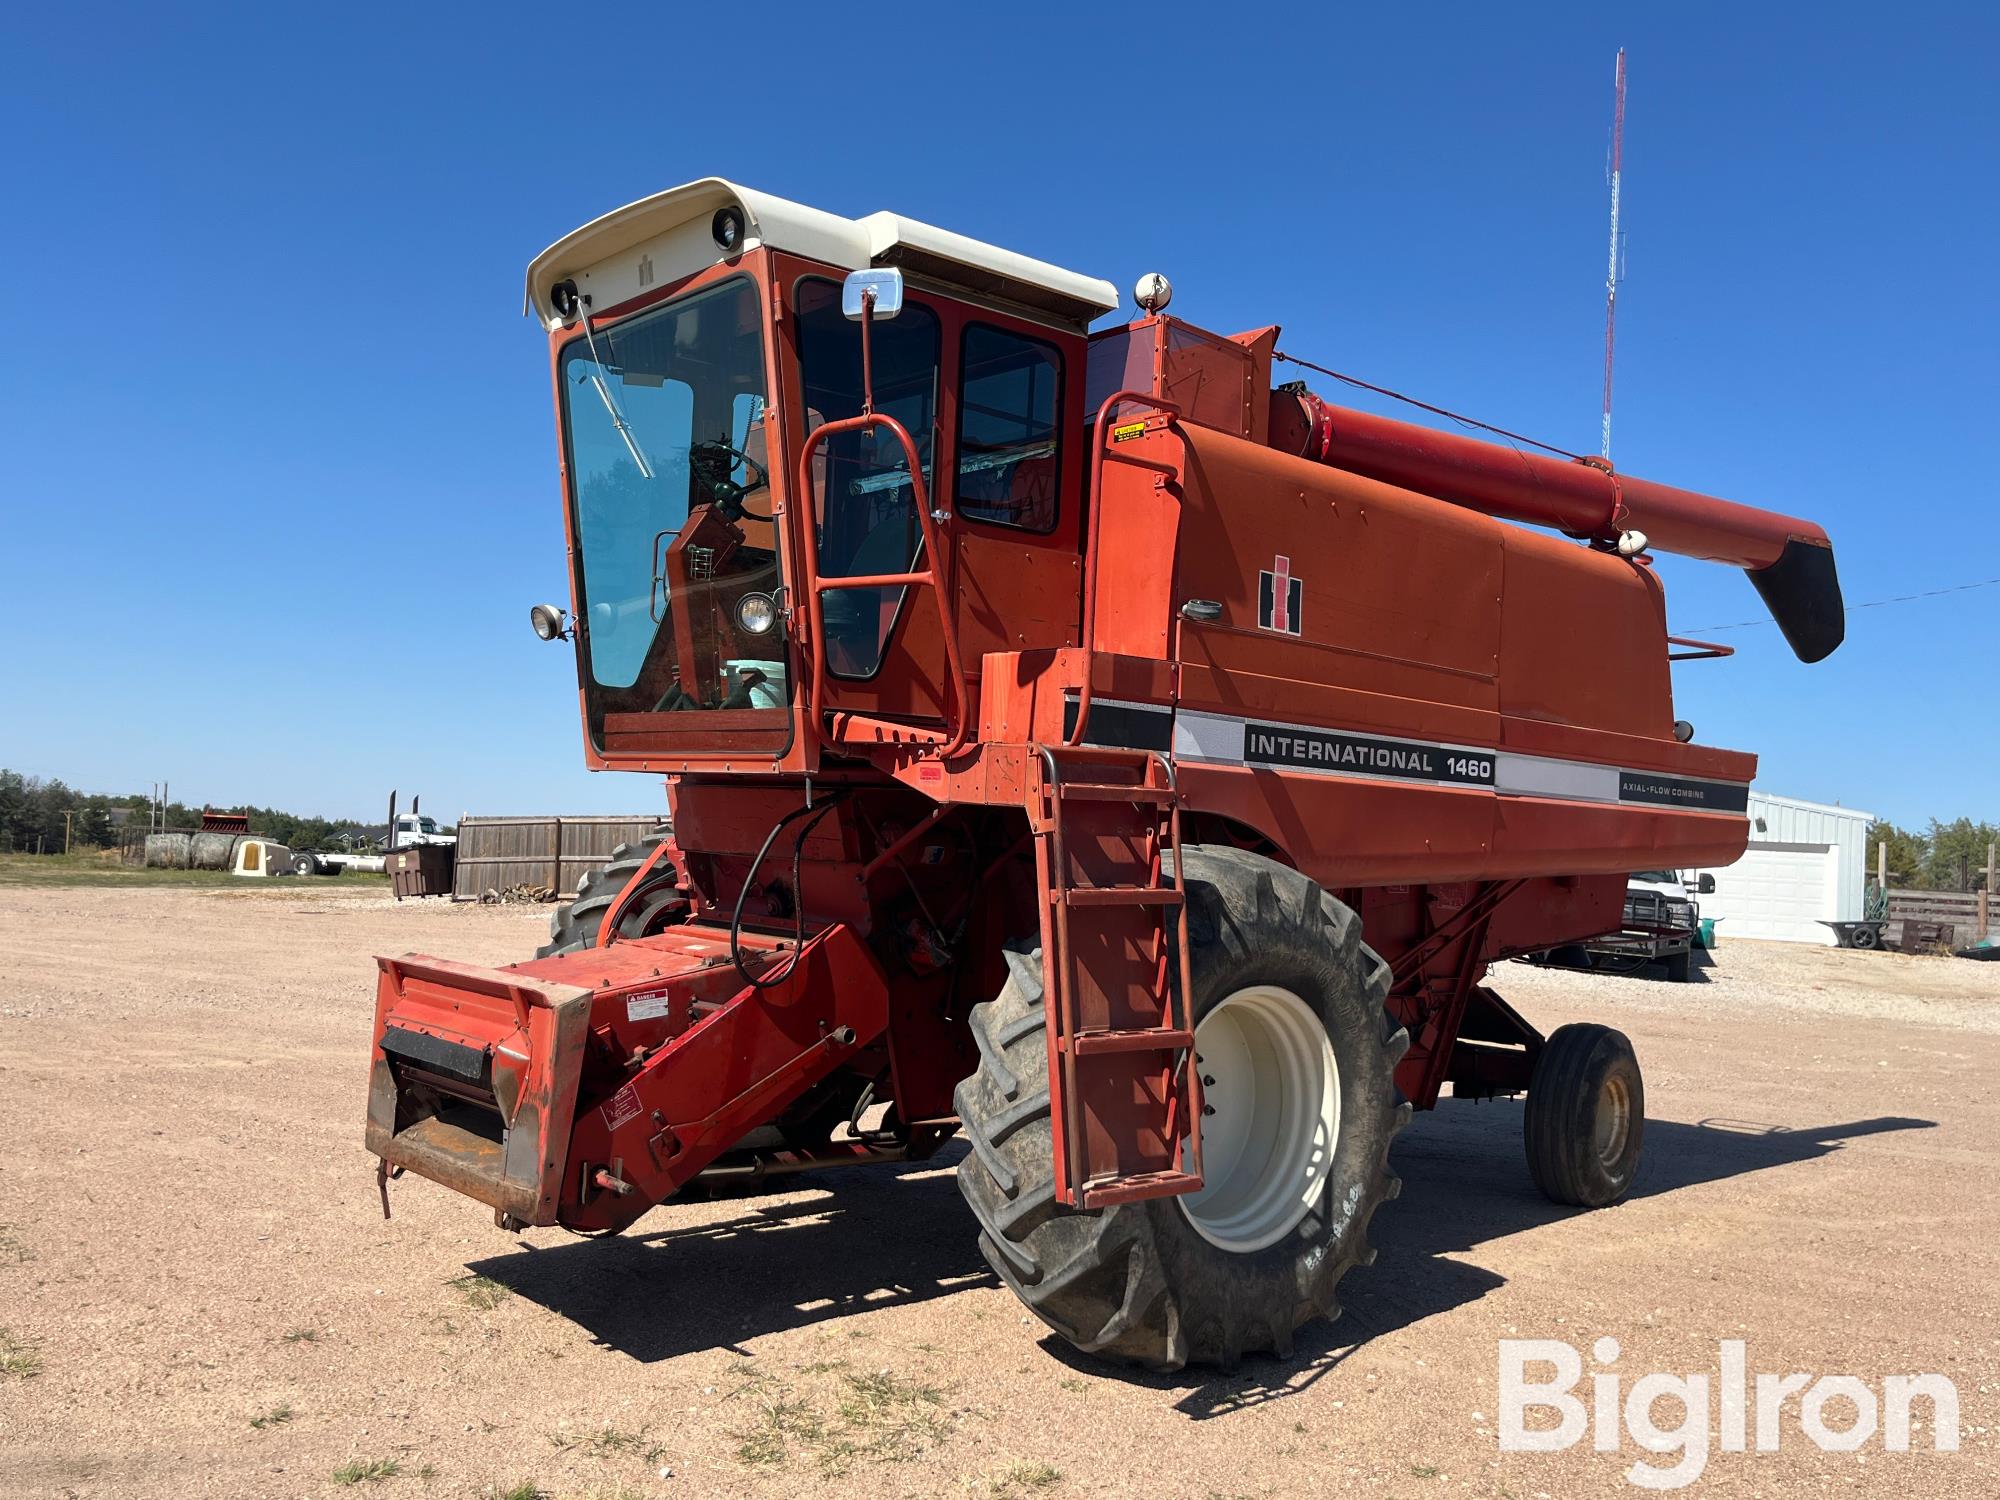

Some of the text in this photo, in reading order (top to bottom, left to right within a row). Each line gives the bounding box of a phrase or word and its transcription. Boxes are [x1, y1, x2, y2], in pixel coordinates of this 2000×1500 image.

[1250, 733, 1491, 779] INTERNATIONAL 1460
[1671, 788, 1704, 799] COMBINE
